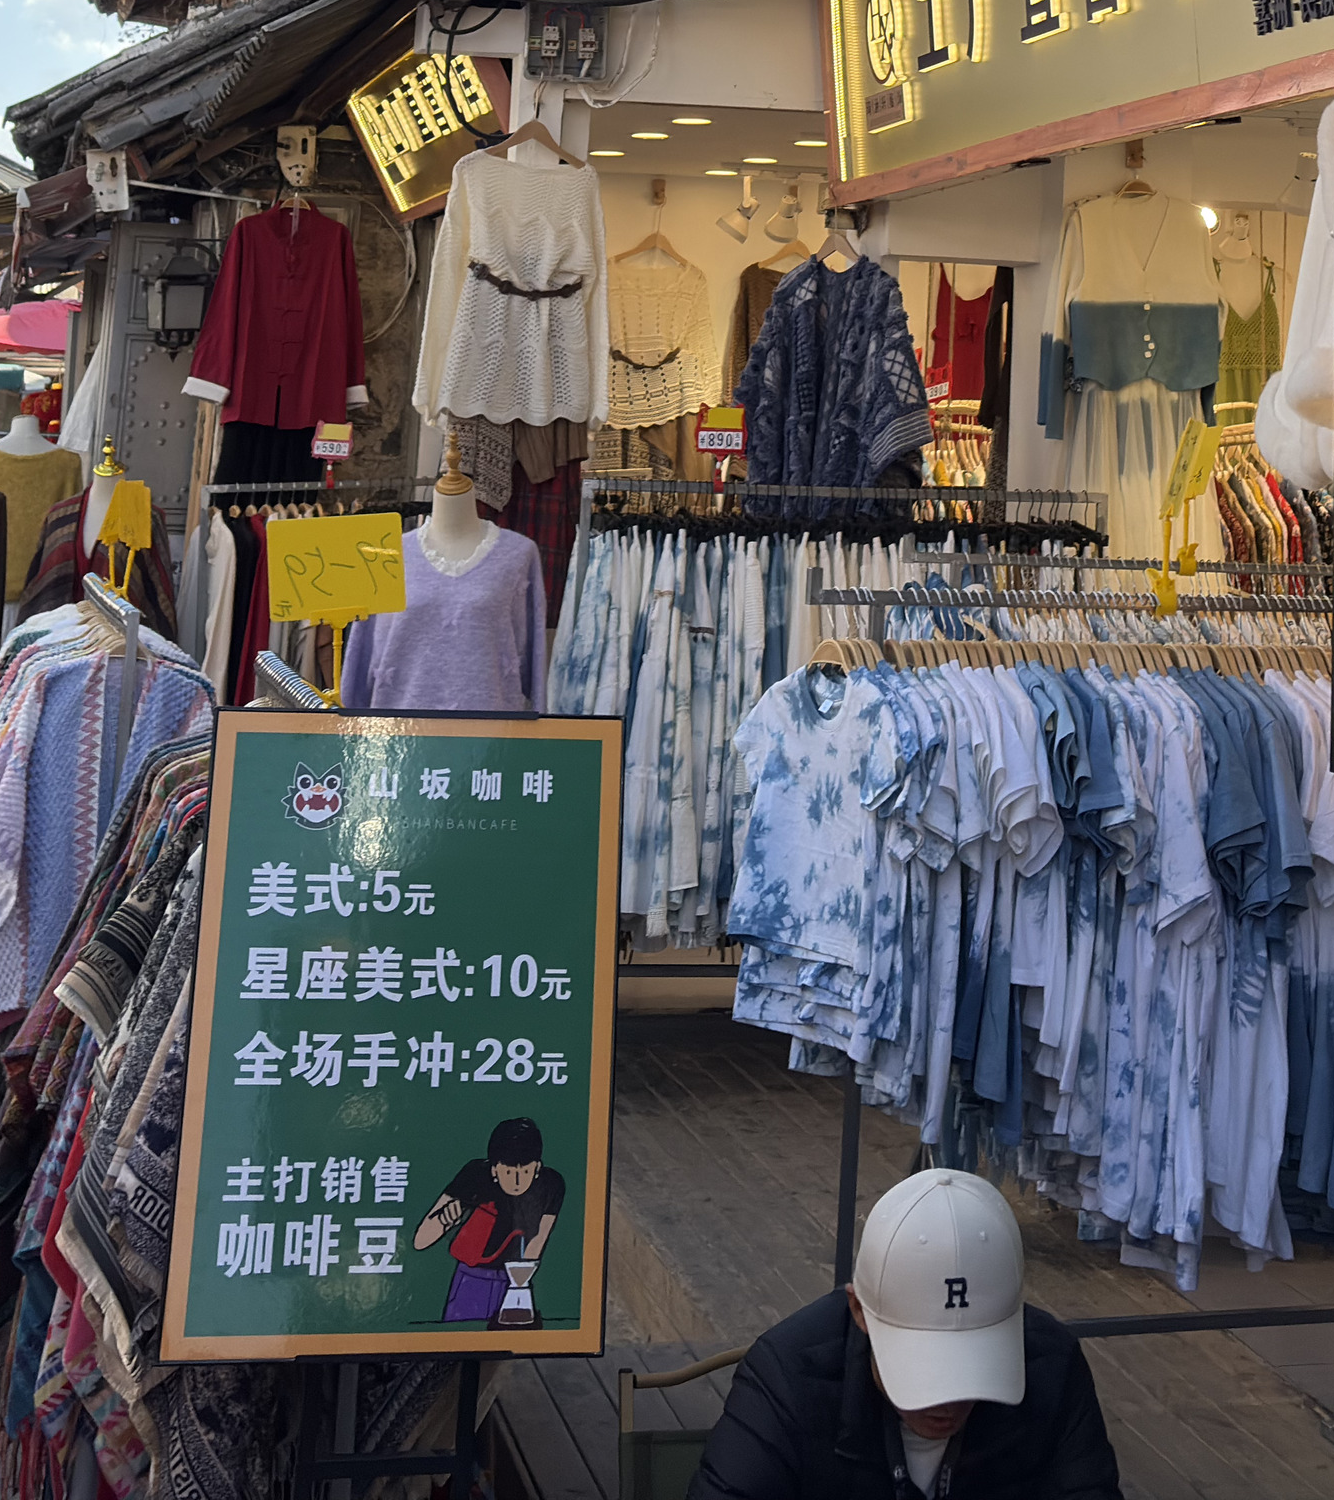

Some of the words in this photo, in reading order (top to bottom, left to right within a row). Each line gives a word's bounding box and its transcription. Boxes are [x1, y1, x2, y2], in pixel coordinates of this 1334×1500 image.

[367, 768, 554, 803] 山坂咖啡
[247, 861, 436, 917] 美式:5元
[239, 946, 572, 1003] 星座美式:10元
[233, 1030, 568, 1088] 全场手冲:28元
[222, 1156, 410, 1204] 主打销售
[216, 1213, 405, 1278] 咖啡豆
[944, 1276, 969, 1309] R
